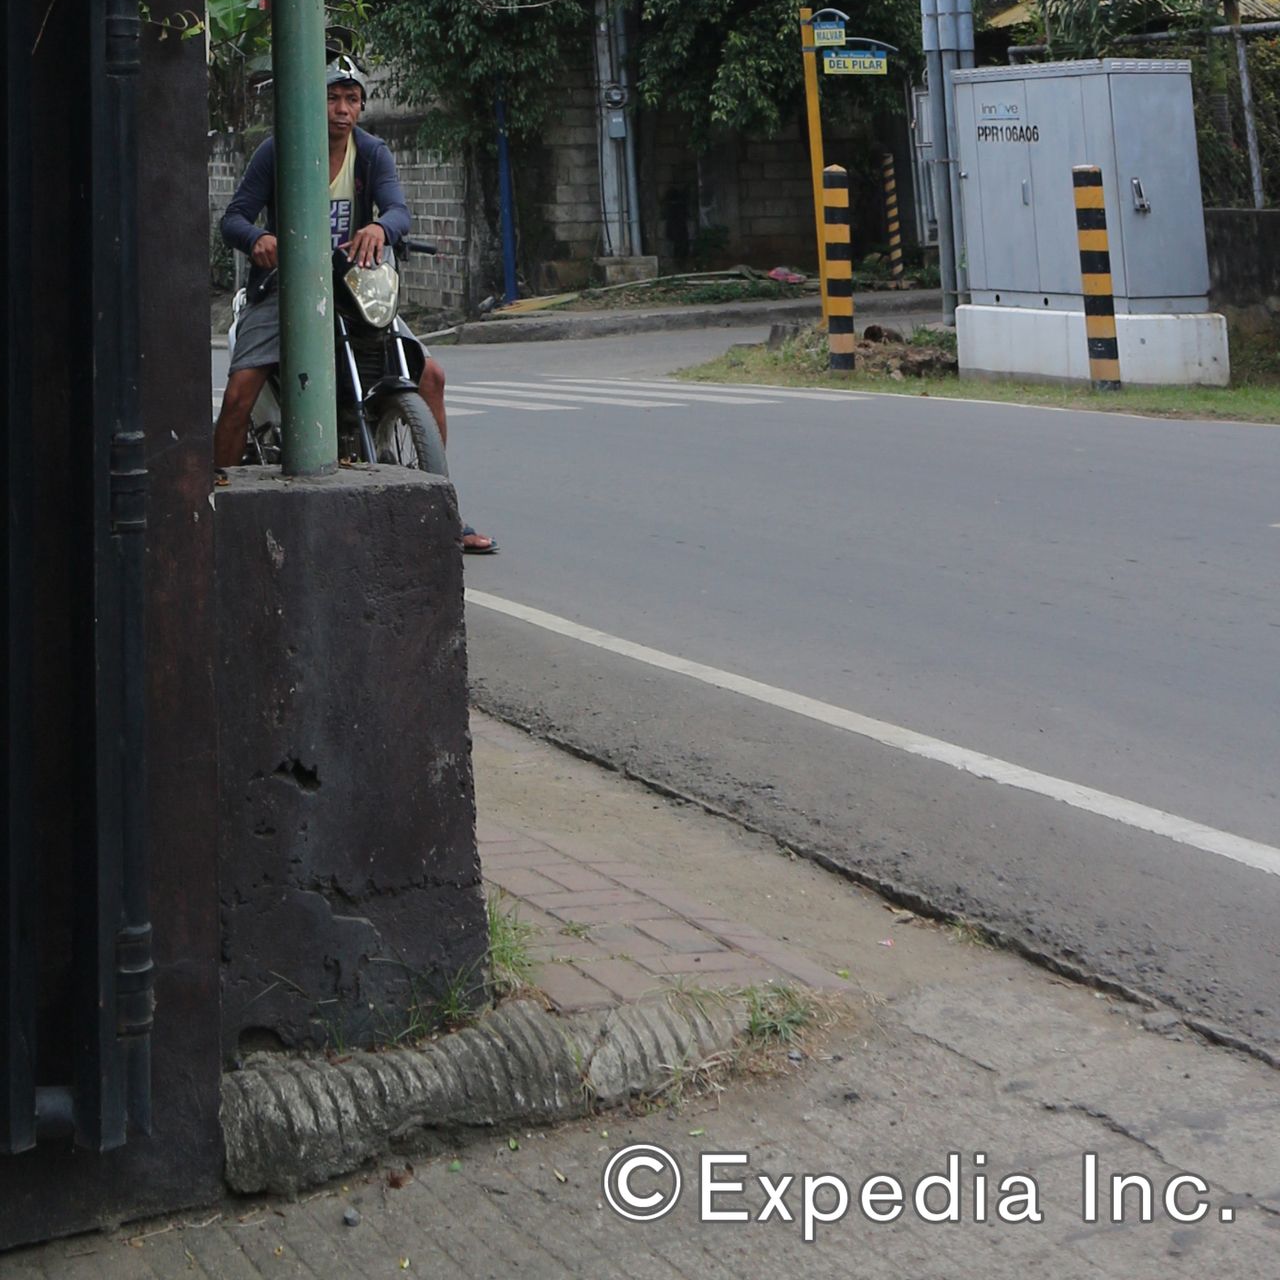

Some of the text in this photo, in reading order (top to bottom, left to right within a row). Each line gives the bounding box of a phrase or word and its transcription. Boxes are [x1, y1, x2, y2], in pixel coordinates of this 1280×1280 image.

[829, 60, 883, 70] DEL PILAR
[977, 125, 1040, 142] PPR106A06
